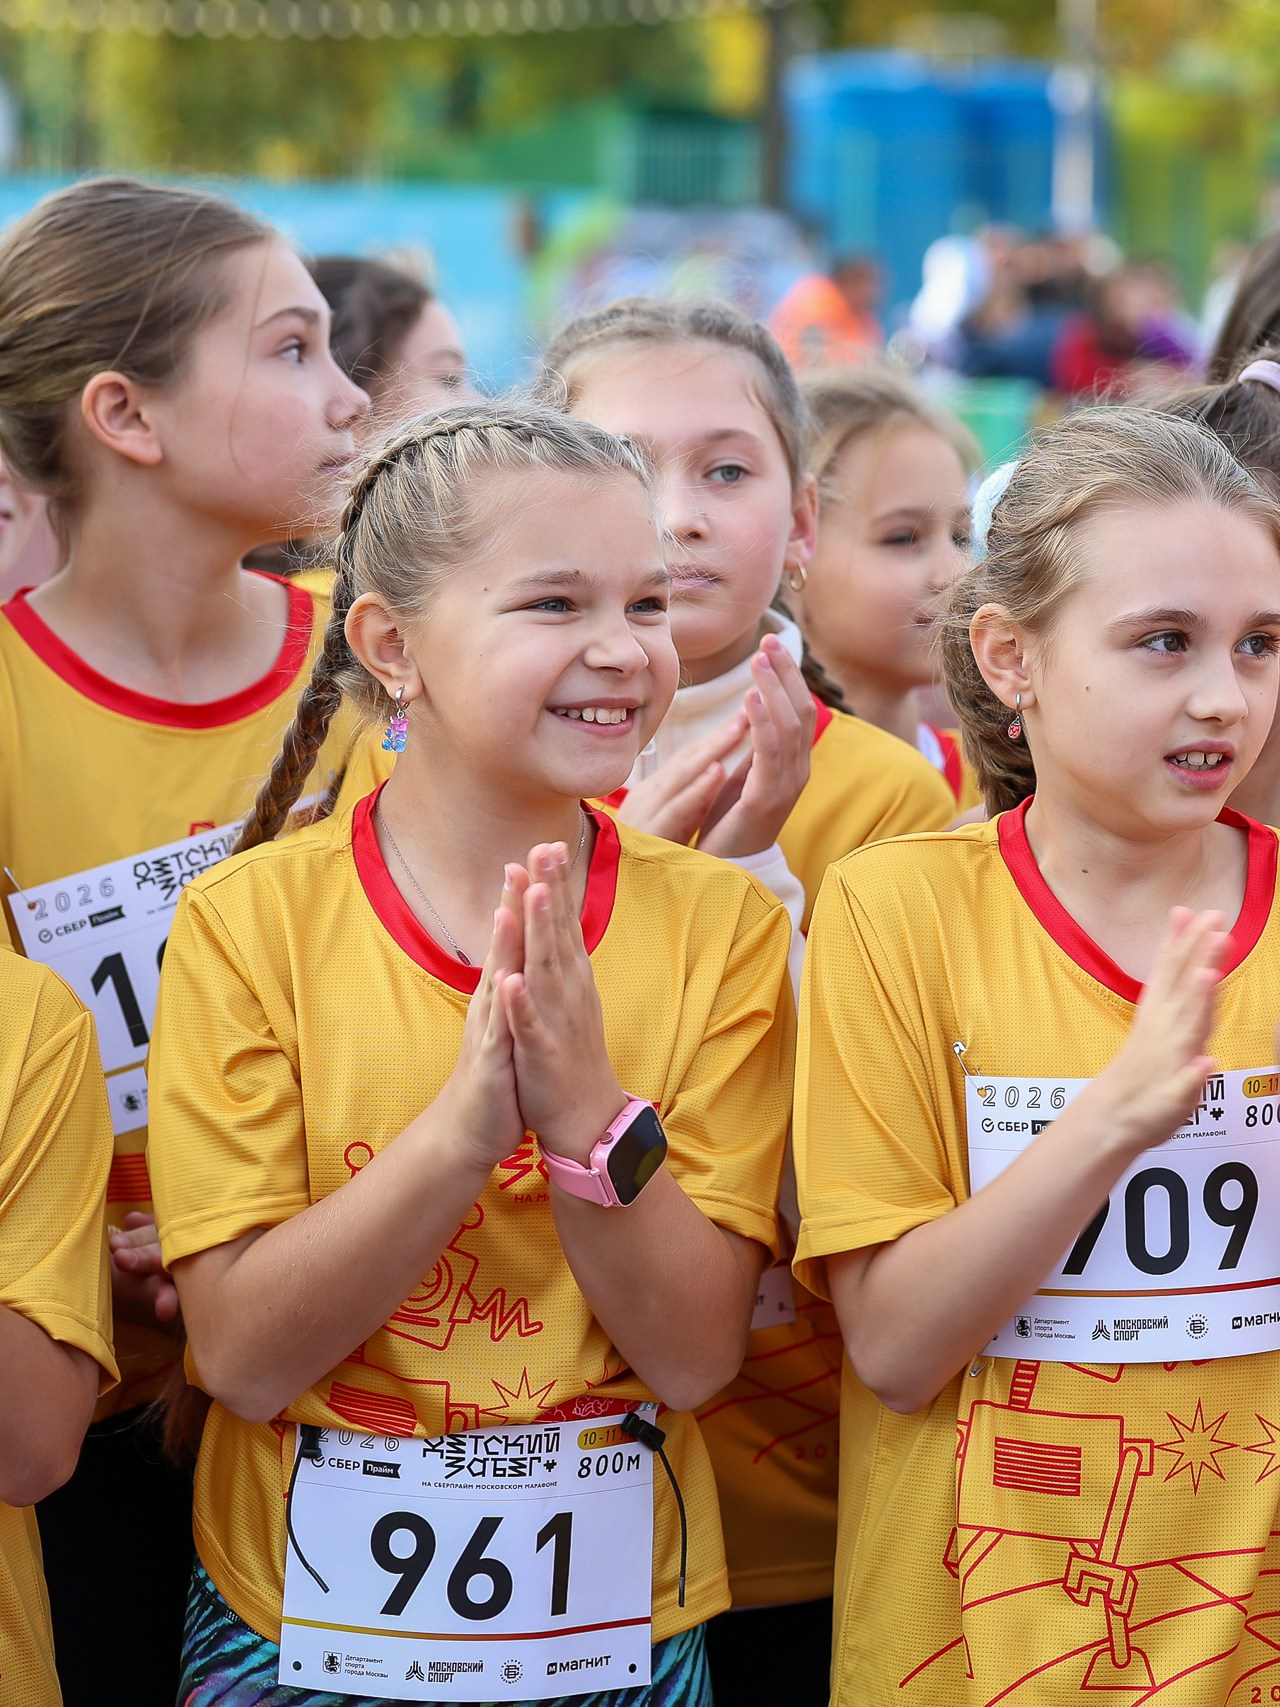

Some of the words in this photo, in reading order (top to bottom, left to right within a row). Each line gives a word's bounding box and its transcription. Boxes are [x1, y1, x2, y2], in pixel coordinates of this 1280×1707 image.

[34, 877, 115, 921] 2026
[55, 919, 87, 937] СБЕР
[983, 1085, 1066, 1109] 2026
[997, 1121, 1029, 1132] СБЕР
[1113, 1315, 1169, 1330] МОСКОВСКИЙ
[1113, 1330, 1140, 1342] СПОРТ
[328, 1457, 360, 1471] СБЕР
[366, 1464, 394, 1474] Прайм
[434, 1481, 474, 1490] СБЕРПРАЙМ
[369, 1510, 573, 1620] 961
[344, 1654, 384, 1664] Департамент
[344, 1662, 365, 1670] спорта
[428, 1659, 484, 1673] МОСКОВСКИЙ
[344, 1668, 365, 1677] города
[365, 1669, 389, 1678] Москвы
[428, 1672, 455, 1684] СПОРТ
